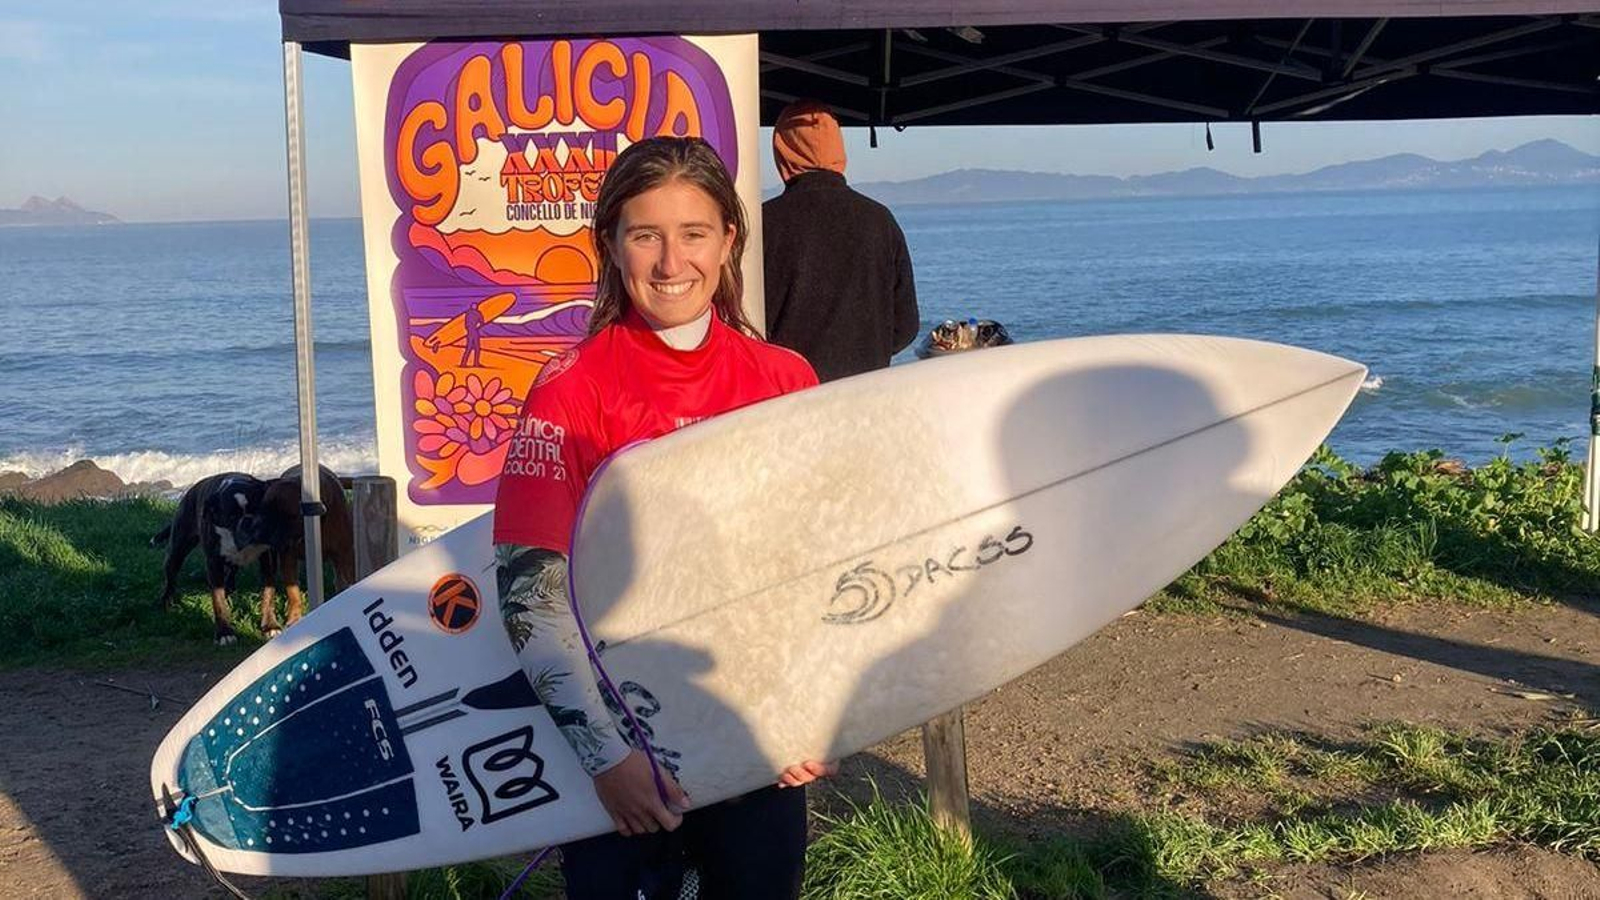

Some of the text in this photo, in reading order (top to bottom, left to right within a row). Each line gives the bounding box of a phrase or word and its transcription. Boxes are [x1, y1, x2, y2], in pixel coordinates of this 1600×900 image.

[396, 39, 702, 226] GALICIA
[500, 172, 604, 204] TROFE
[506, 202, 599, 221] CONCELLO DE NI
[507, 438, 564, 465] DENTAL
[362, 597, 418, 689] Idden
[364, 698, 394, 761] FCS
[435, 754, 476, 832] WAIRA
